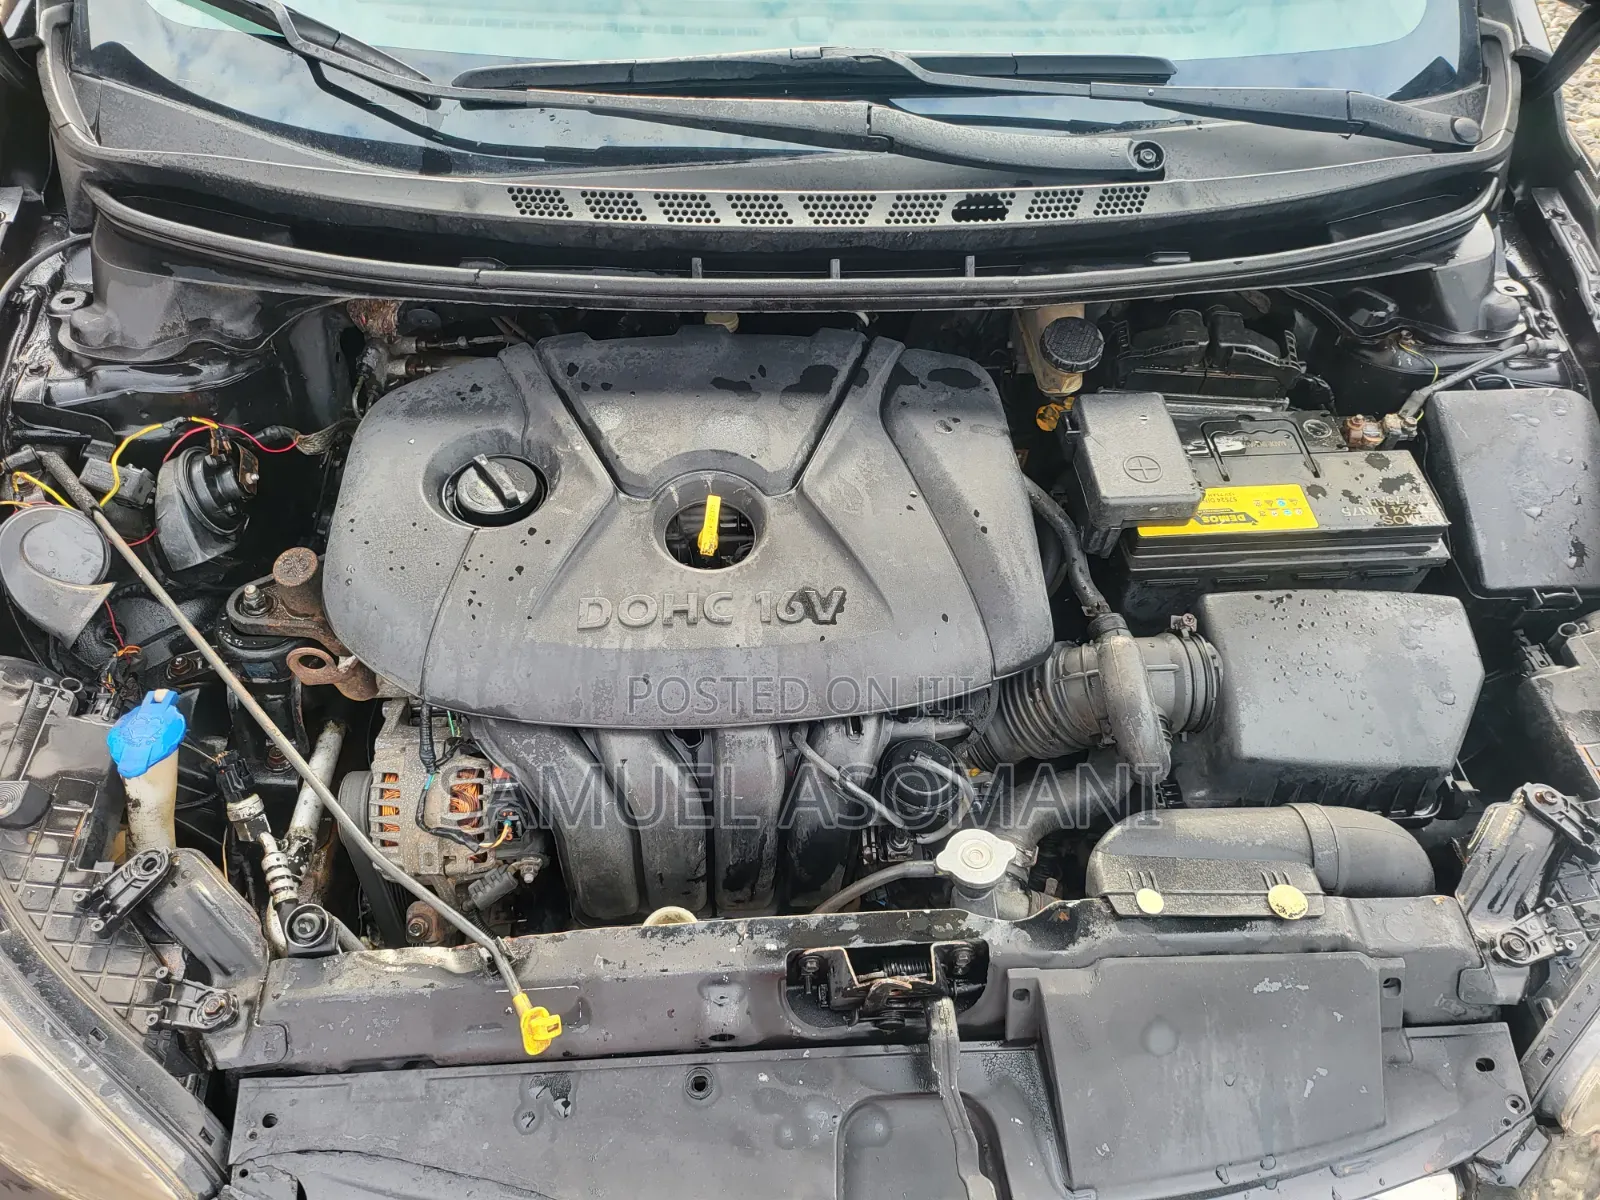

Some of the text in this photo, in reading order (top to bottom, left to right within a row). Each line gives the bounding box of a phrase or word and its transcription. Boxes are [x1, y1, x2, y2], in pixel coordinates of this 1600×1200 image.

[1341, 505, 1389, 517] DIN75
[1201, 514, 1247, 524] DEMOS
[577, 589, 844, 630] DOHC 16V
